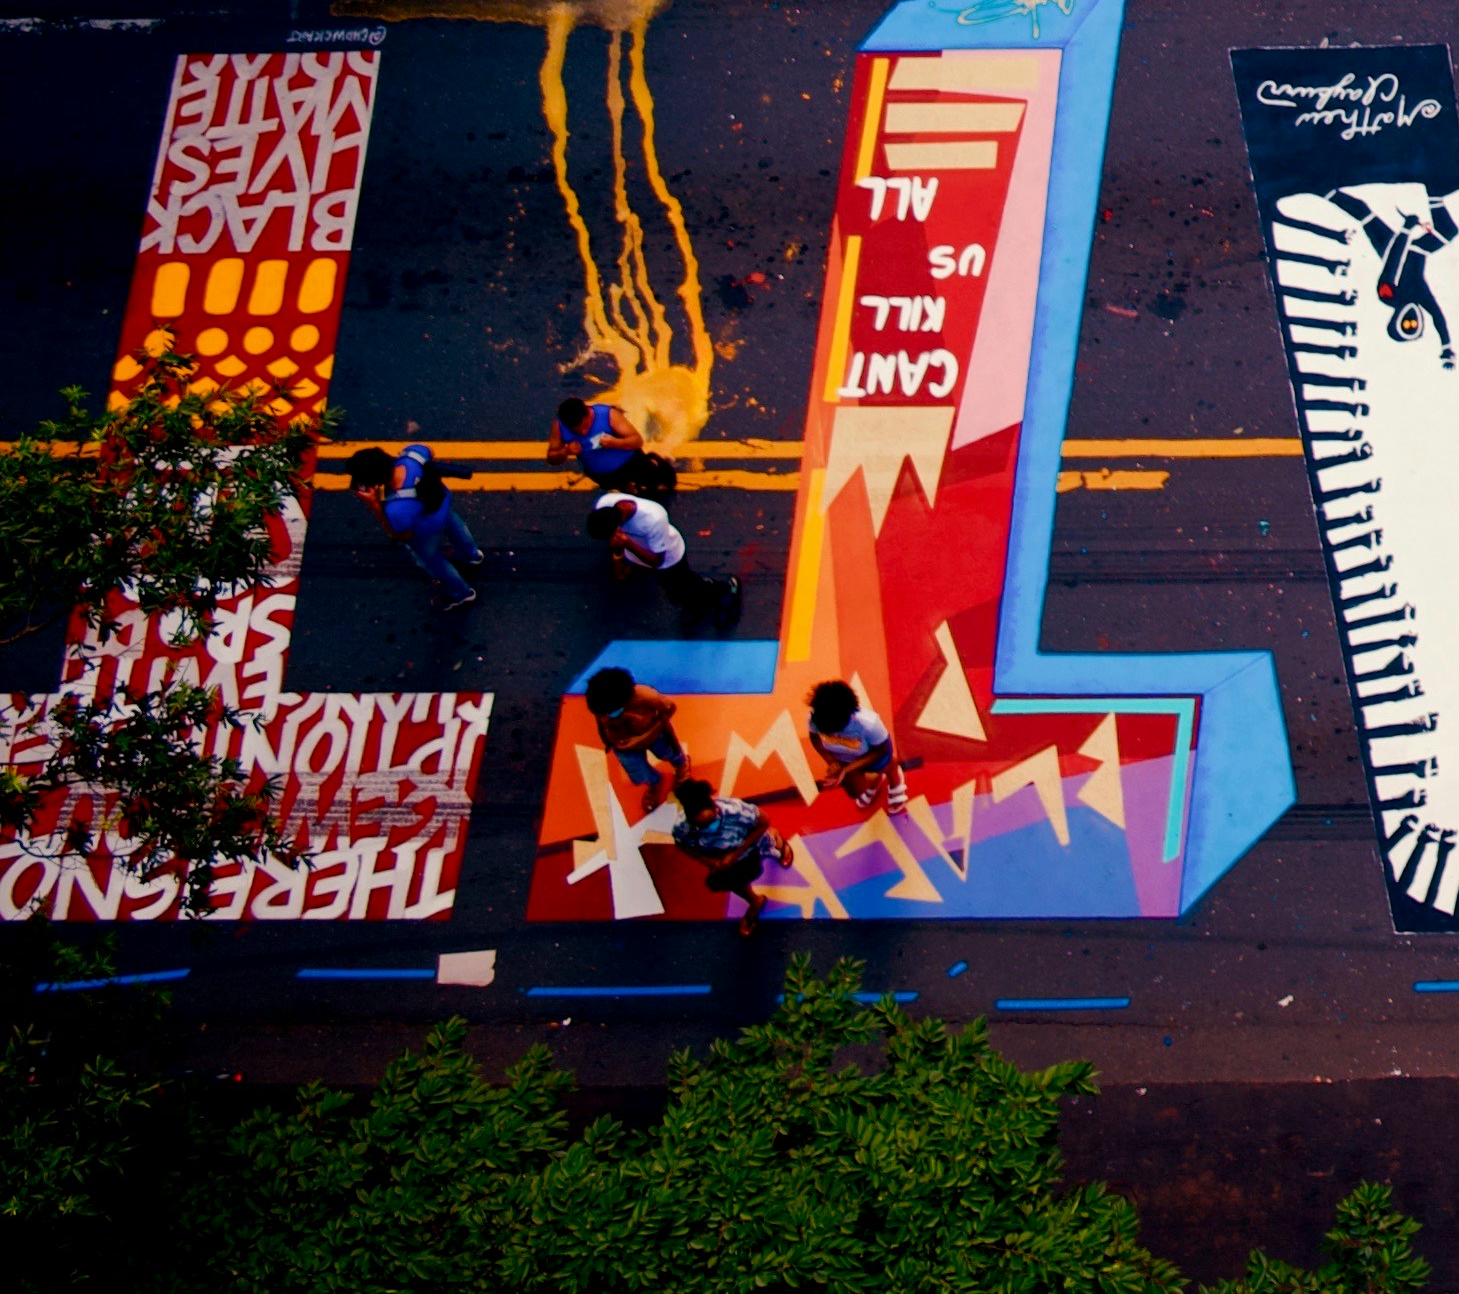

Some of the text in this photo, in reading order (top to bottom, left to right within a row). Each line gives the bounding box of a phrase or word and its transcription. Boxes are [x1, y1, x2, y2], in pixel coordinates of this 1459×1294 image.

[166, 131, 370, 199] LIVES
[140, 189, 355, 255] BLACK
[853, 176, 939, 222] ALL
[928, 243, 986, 279] US
[860, 295, 946, 333] KILL
[835, 348, 959, 398] CANT
